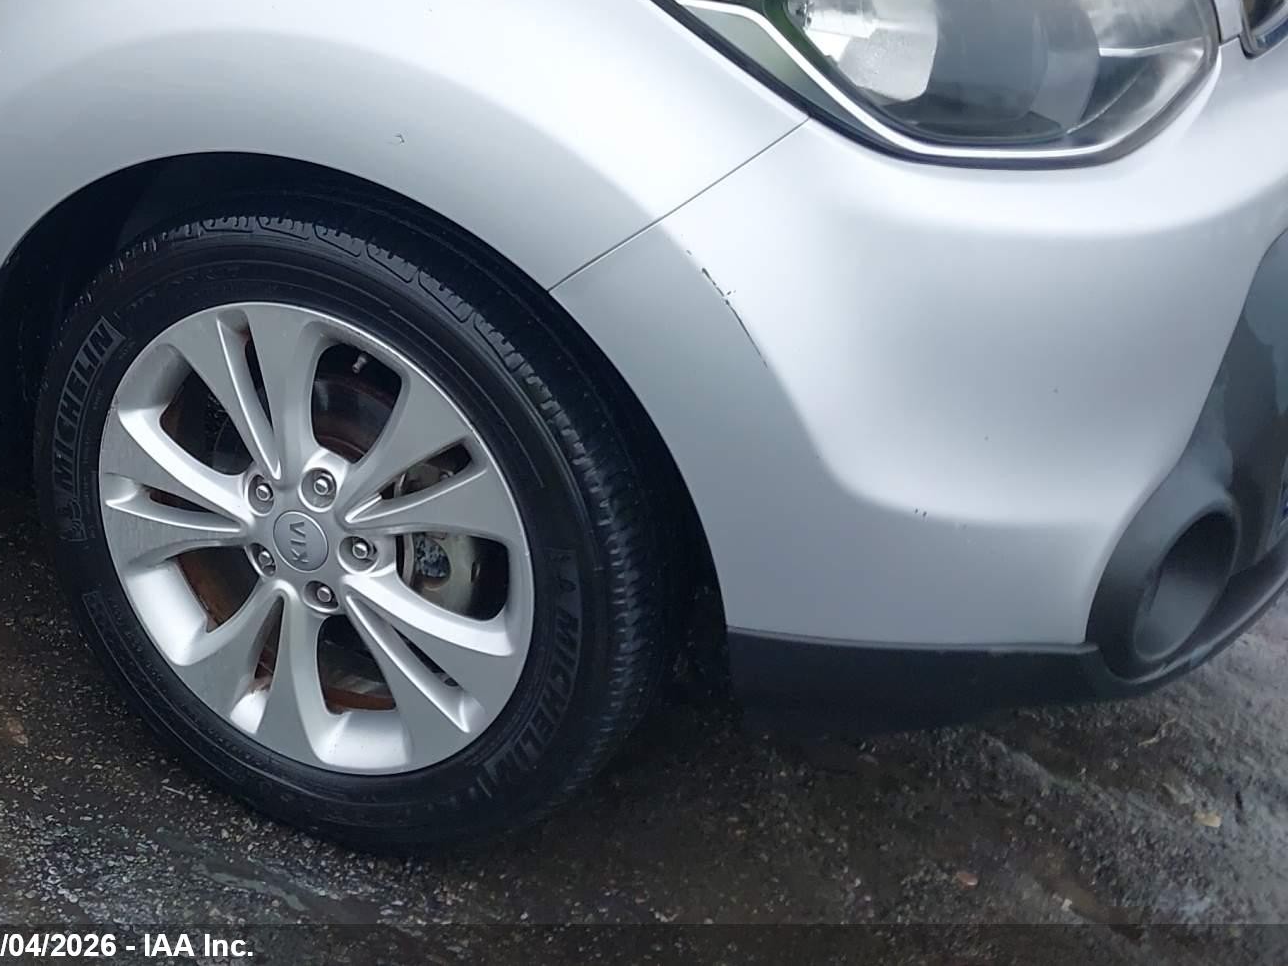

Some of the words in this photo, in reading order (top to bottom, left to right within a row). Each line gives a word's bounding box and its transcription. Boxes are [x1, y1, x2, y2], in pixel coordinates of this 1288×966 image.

[53, 320, 115, 495] MICHELIN
[289, 521, 310, 563] KIA
[493, 607, 580, 783] MICHELIN
